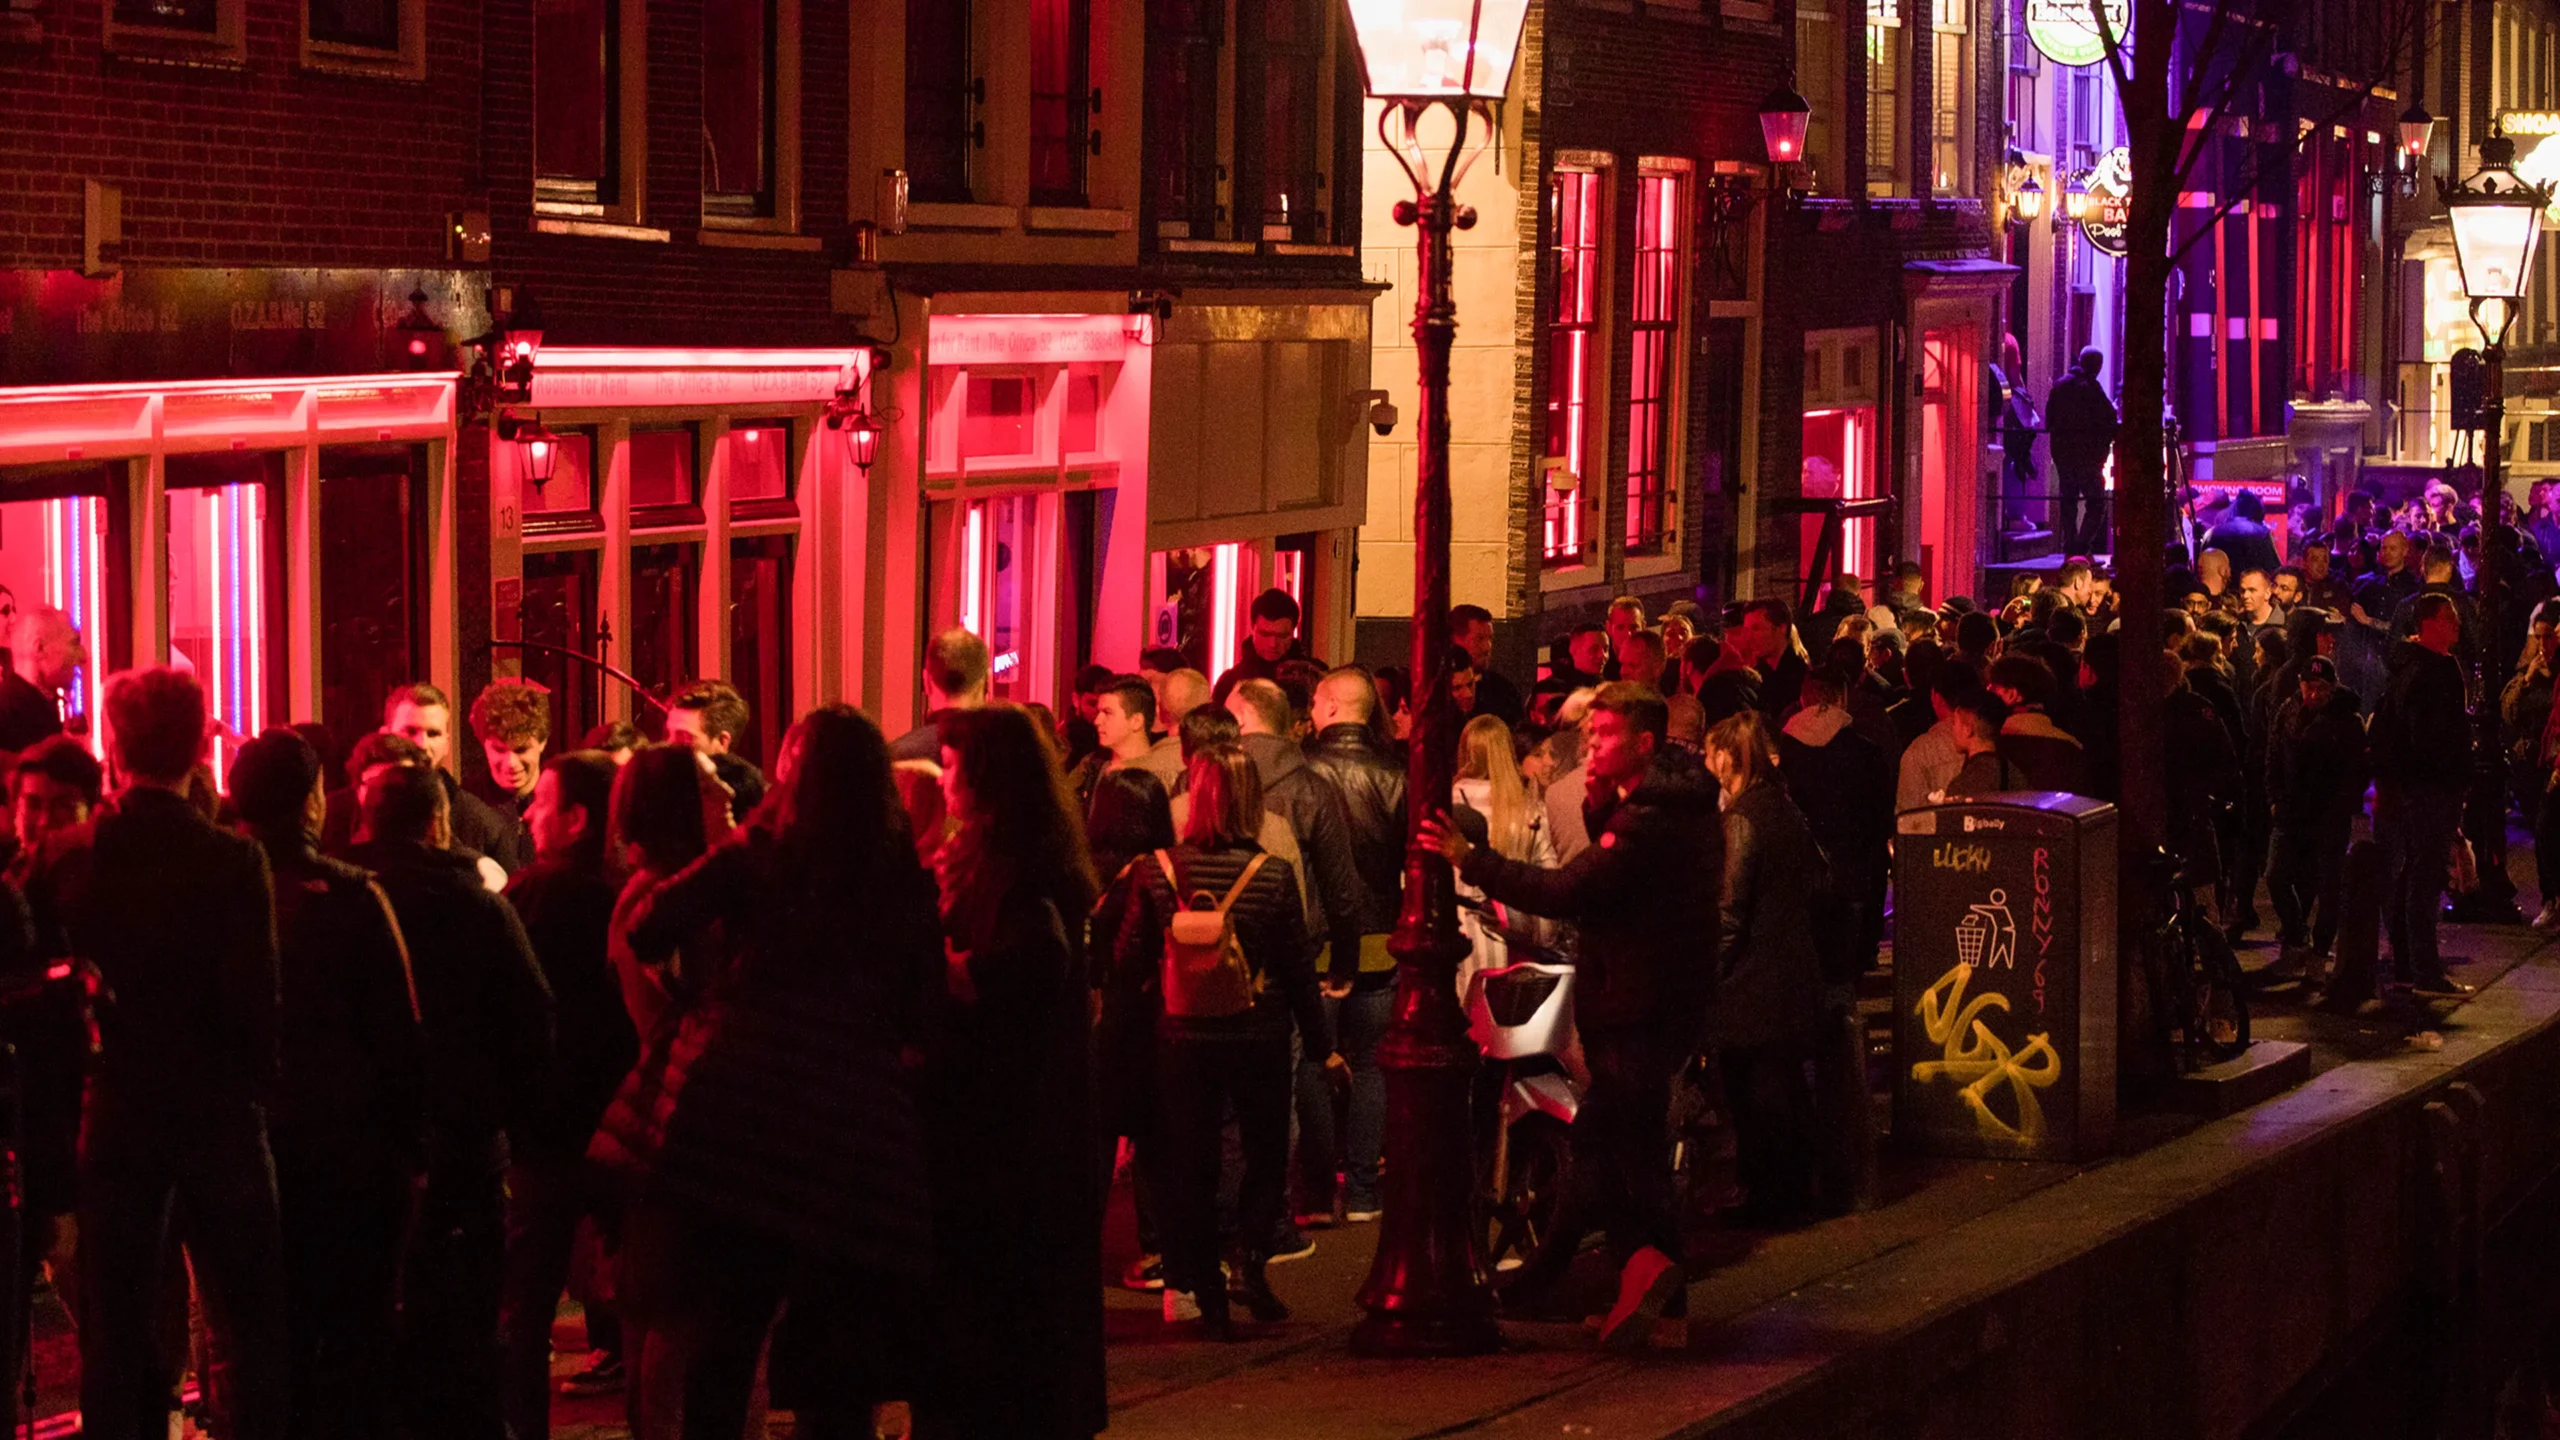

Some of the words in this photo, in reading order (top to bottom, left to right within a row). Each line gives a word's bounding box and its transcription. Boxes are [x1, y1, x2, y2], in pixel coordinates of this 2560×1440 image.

[2088, 197, 2122, 207] BLACK
[2104, 208, 2130, 222] BA
[988, 332, 1004, 352] The
[1008, 332, 1037, 352] Office
[536, 377, 577, 397] Rooms
[581, 375, 598, 397] for
[601, 376, 628, 397] Rent
[655, 373, 673, 395] The
[678, 373, 712, 395] Office
[2247, 486, 2282, 496] ROOM
[501, 506, 513, 530] 13
